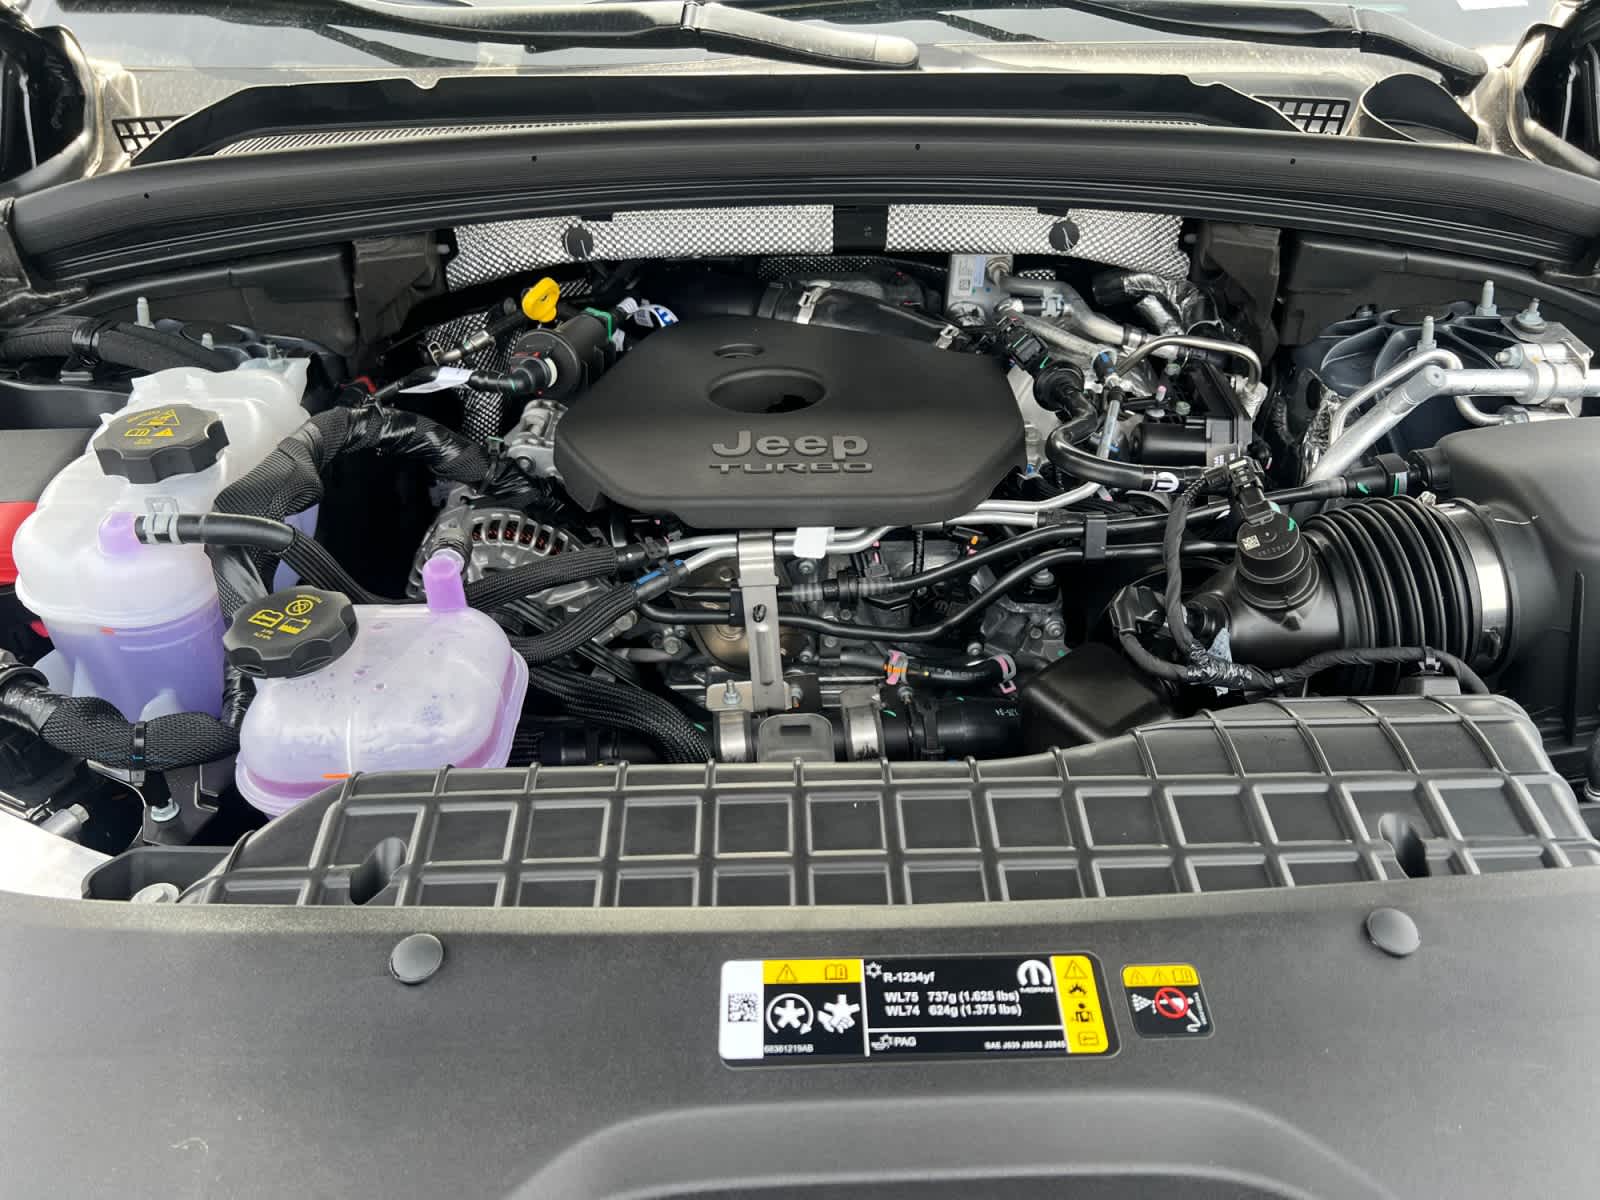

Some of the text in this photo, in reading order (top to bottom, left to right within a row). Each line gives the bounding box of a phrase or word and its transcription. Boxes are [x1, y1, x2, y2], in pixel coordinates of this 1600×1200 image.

[712, 430, 868, 462] Jeep
[709, 463, 873, 474] TURBO
[883, 971, 935, 984] R-1234yf
[884, 992, 919, 1003] WL75
[927, 991, 957, 1005] 737g
[959, 991, 994, 1004] (1.625
[996, 990, 1020, 1003] lbs)
[885, 1005, 920, 1016] WL74
[928, 1004, 959, 1018] 624g
[998, 1003, 1022, 1016] lbs)
